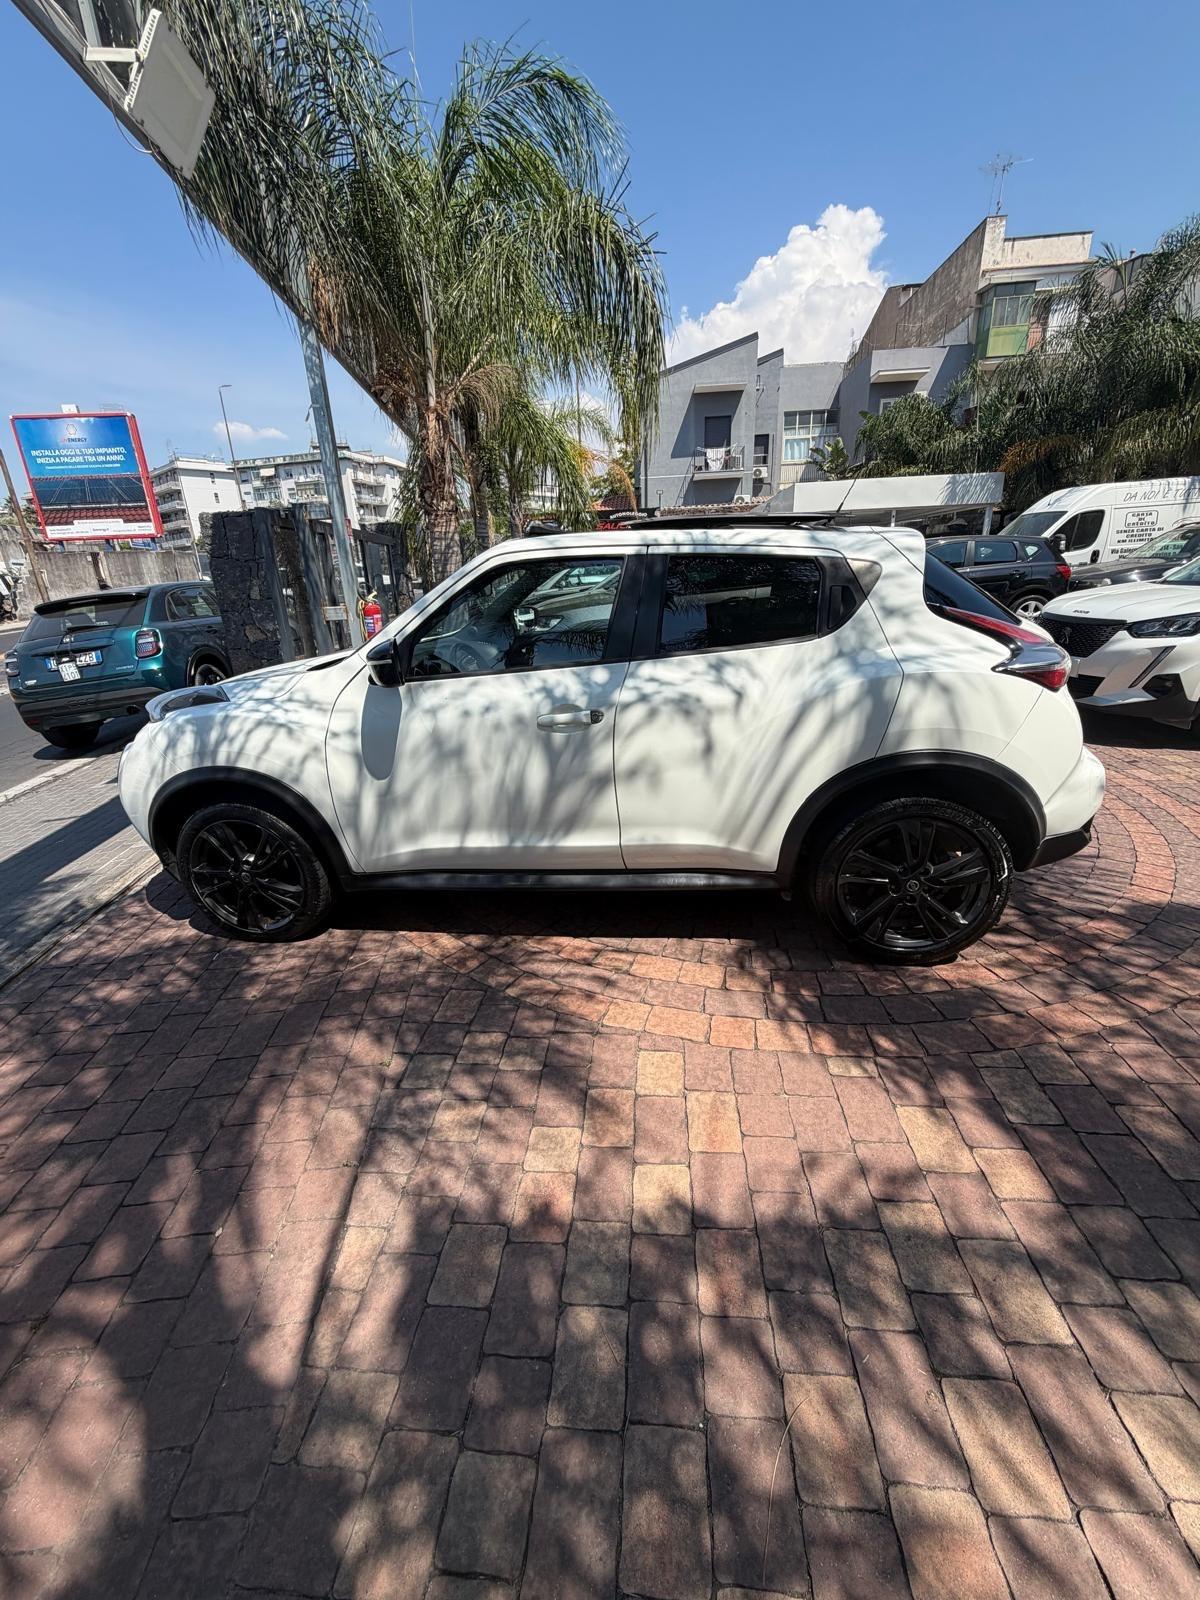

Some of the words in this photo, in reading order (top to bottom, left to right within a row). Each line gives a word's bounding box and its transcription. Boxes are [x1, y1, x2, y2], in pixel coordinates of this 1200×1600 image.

[61, 448, 75, 456] OGGI
[1124, 492, 1138, 501] DA
[1140, 490, 1160, 500] NOI
